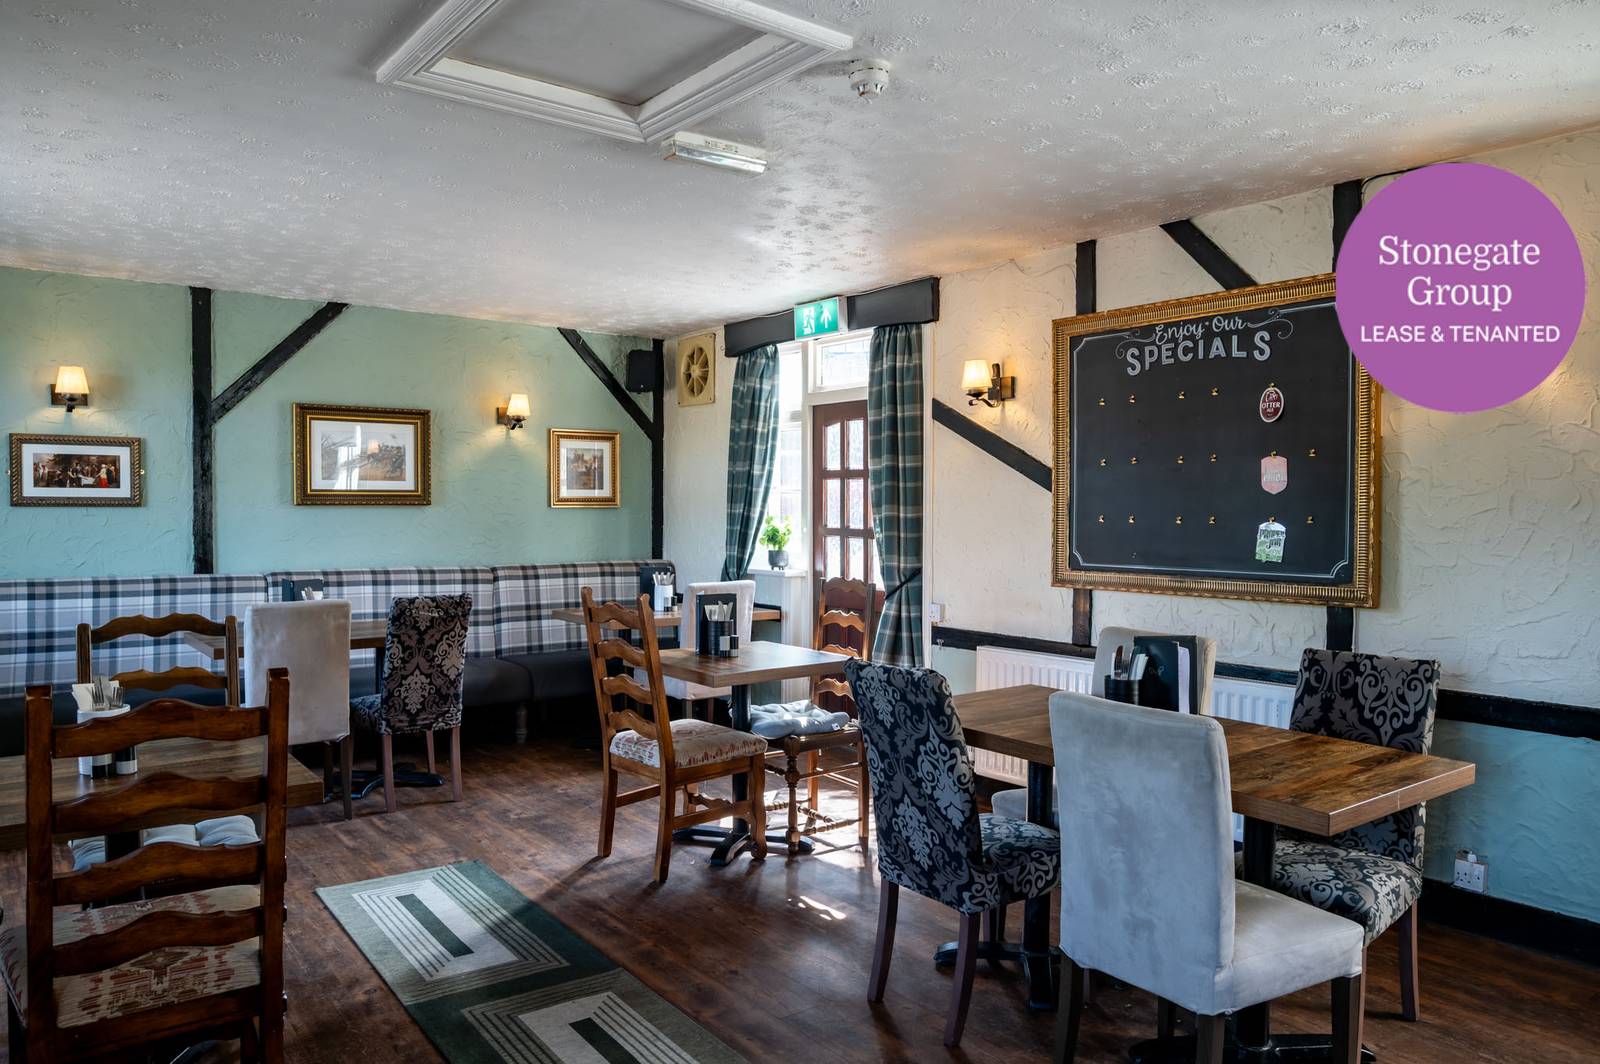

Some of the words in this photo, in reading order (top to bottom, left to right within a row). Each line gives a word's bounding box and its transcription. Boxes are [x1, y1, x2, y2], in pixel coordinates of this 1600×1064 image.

[1155, 322, 1205, 345] Enjoy
[1212, 316, 1246, 332] Our
[1126, 330, 1271, 376] SPECIALS
